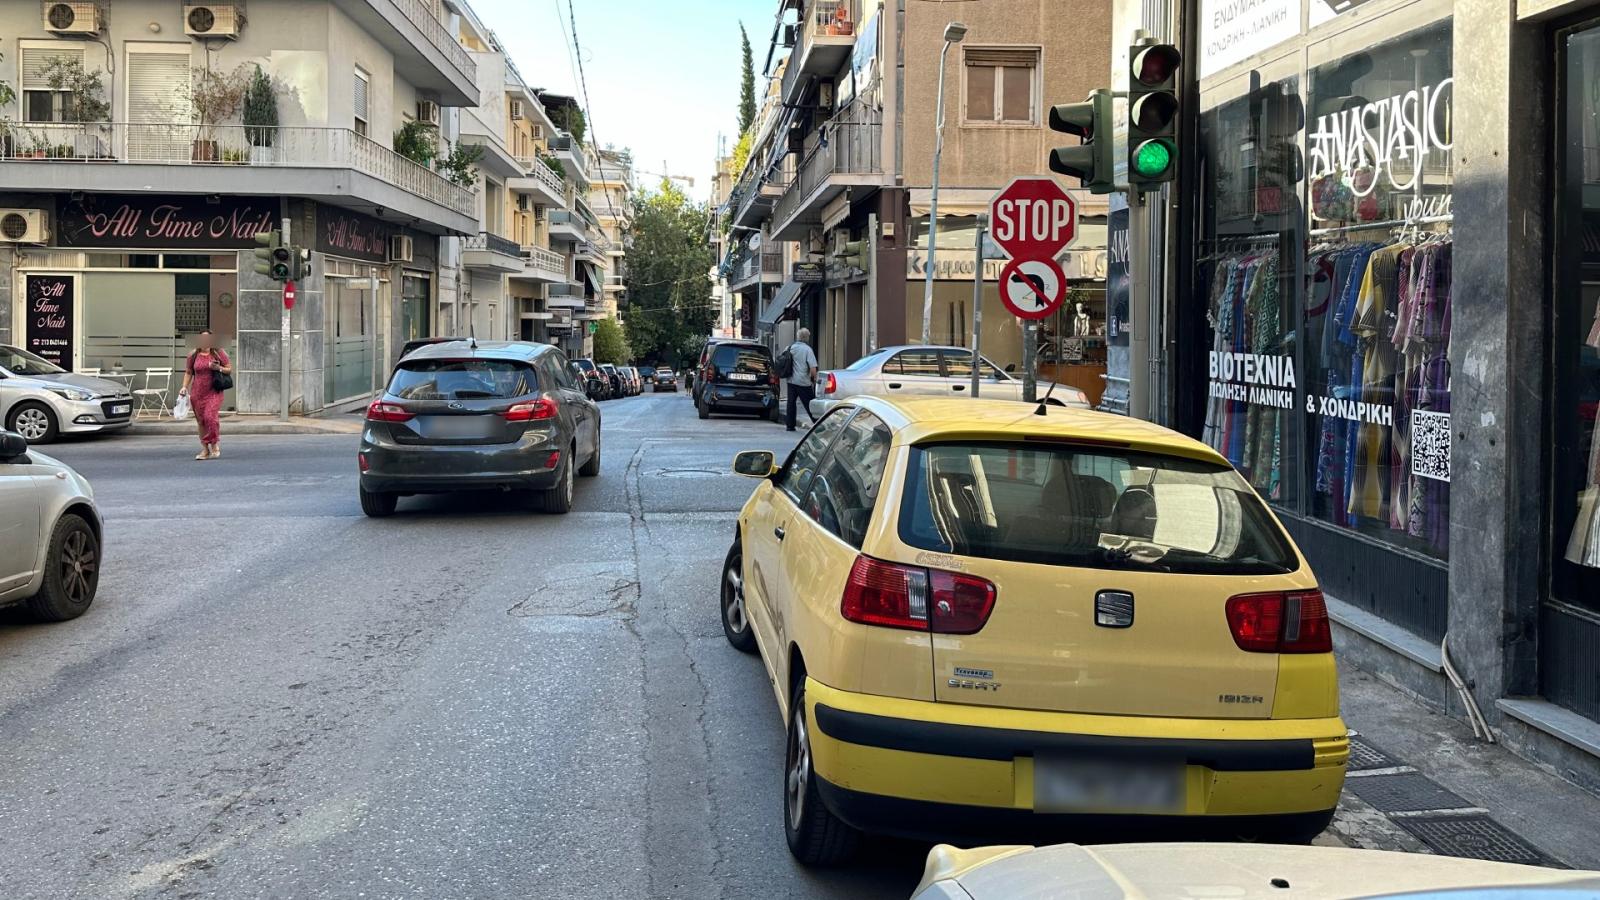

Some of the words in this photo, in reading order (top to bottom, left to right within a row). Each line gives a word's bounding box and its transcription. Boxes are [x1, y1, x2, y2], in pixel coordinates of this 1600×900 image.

[1214, 0, 1266, 29] ΕΝΔΥΜΑ
[1207, 28, 1245, 57] ΧΟΝΔΡΙΚΗ
[1251, 5, 1287, 36] ΛΙΑΝΙΚΗ
[92, 204, 143, 238] All
[146, 204, 205, 239] Time
[210, 206, 272, 239] Nails
[997, 199, 1070, 241] STOP
[43, 282, 66, 297] All
[33, 297, 60, 313] Time
[37, 313, 66, 328] Nails
[1209, 350, 1296, 388] ΒΙΟΤΕΧΝΙΑ
[1209, 382, 1247, 402] ΠΩΛΗΣΗ
[1249, 386, 1293, 409] ΛΙΑΝΙΚΗ
[1306, 395, 1315, 413] &
[1319, 396, 1392, 426] ΧΟΝΔΡΙΚΗ
[948, 679, 1002, 691] SEAT
[1218, 694, 1264, 704] IBIZA
